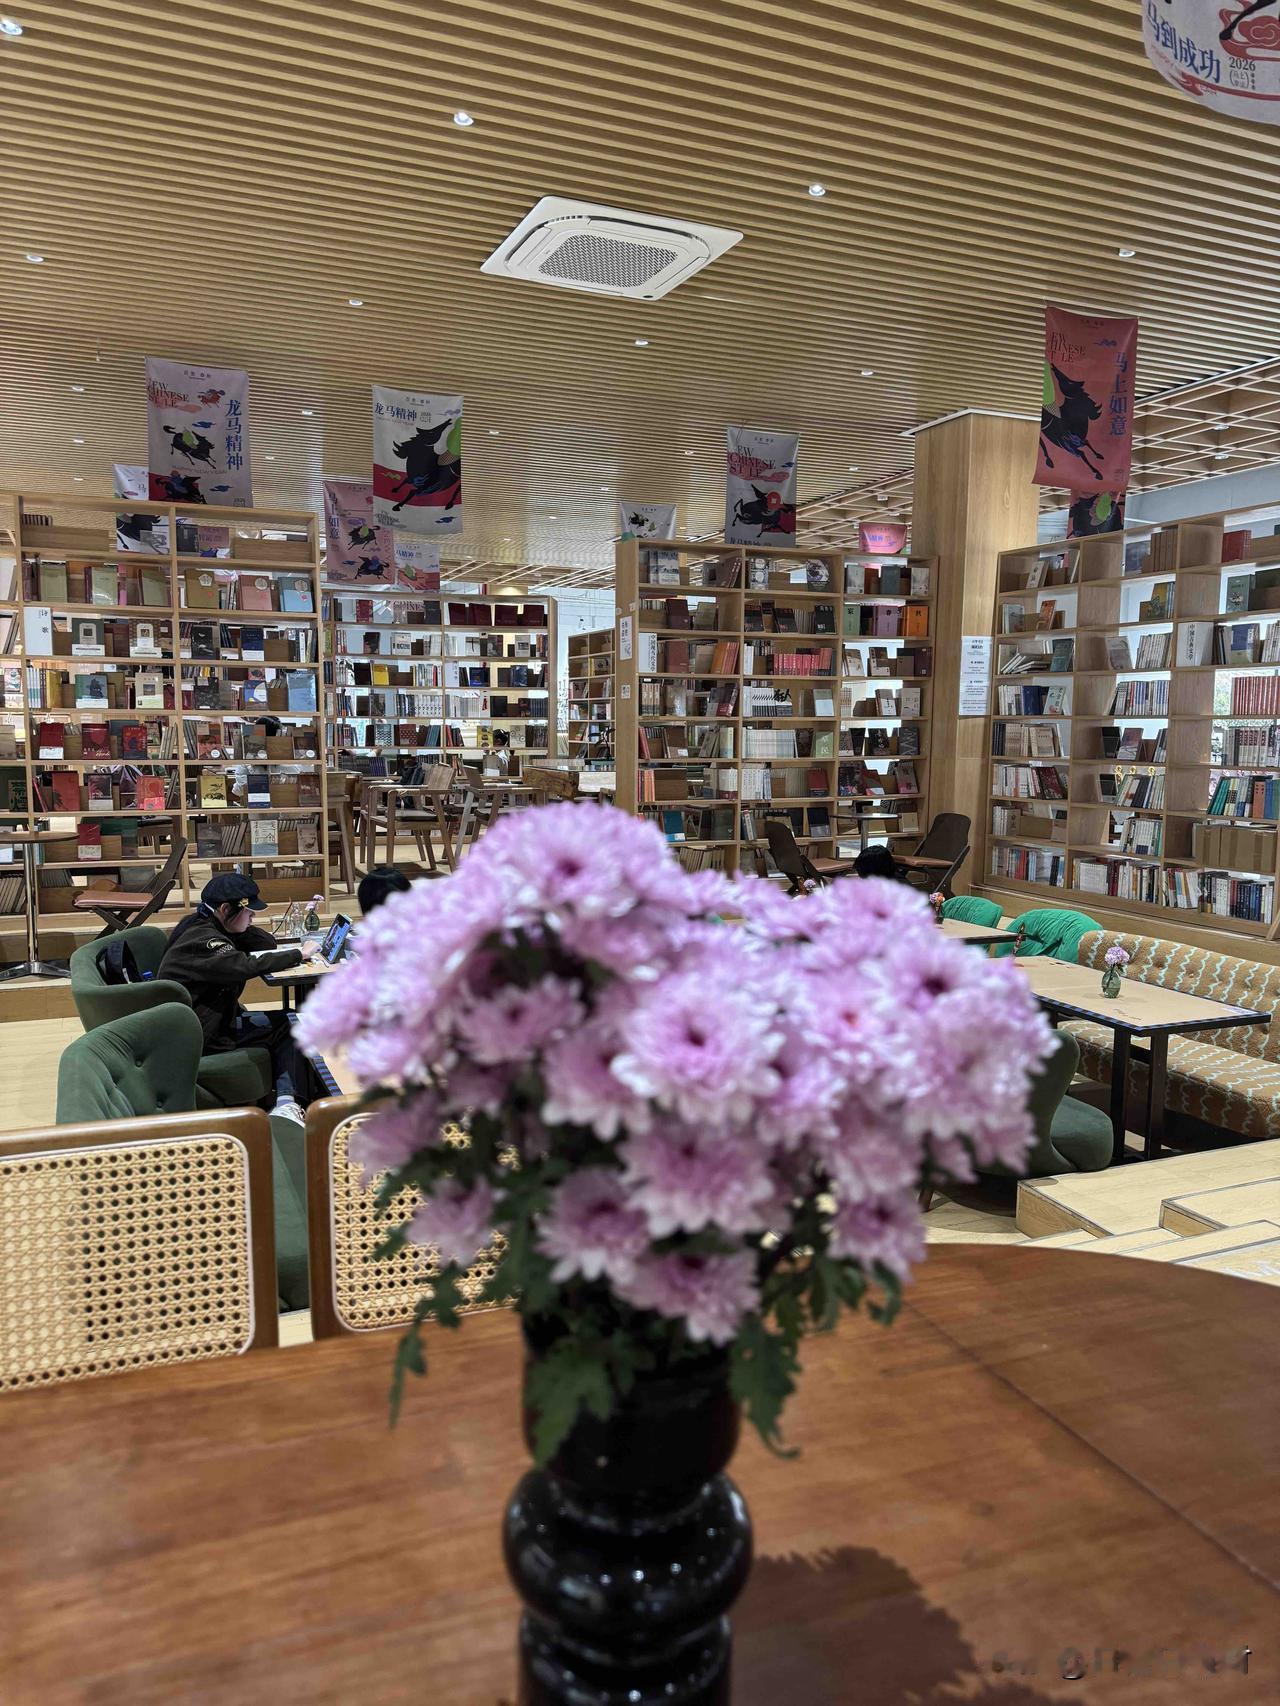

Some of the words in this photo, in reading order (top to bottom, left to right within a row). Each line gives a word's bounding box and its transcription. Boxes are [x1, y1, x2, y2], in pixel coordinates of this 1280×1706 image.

[1229, 57, 1256, 72] 2026
[375, 402, 417, 422] 龙马精神
[1109, 351, 1128, 437] 马上如意
[225, 399, 243, 471] 龙马精神
